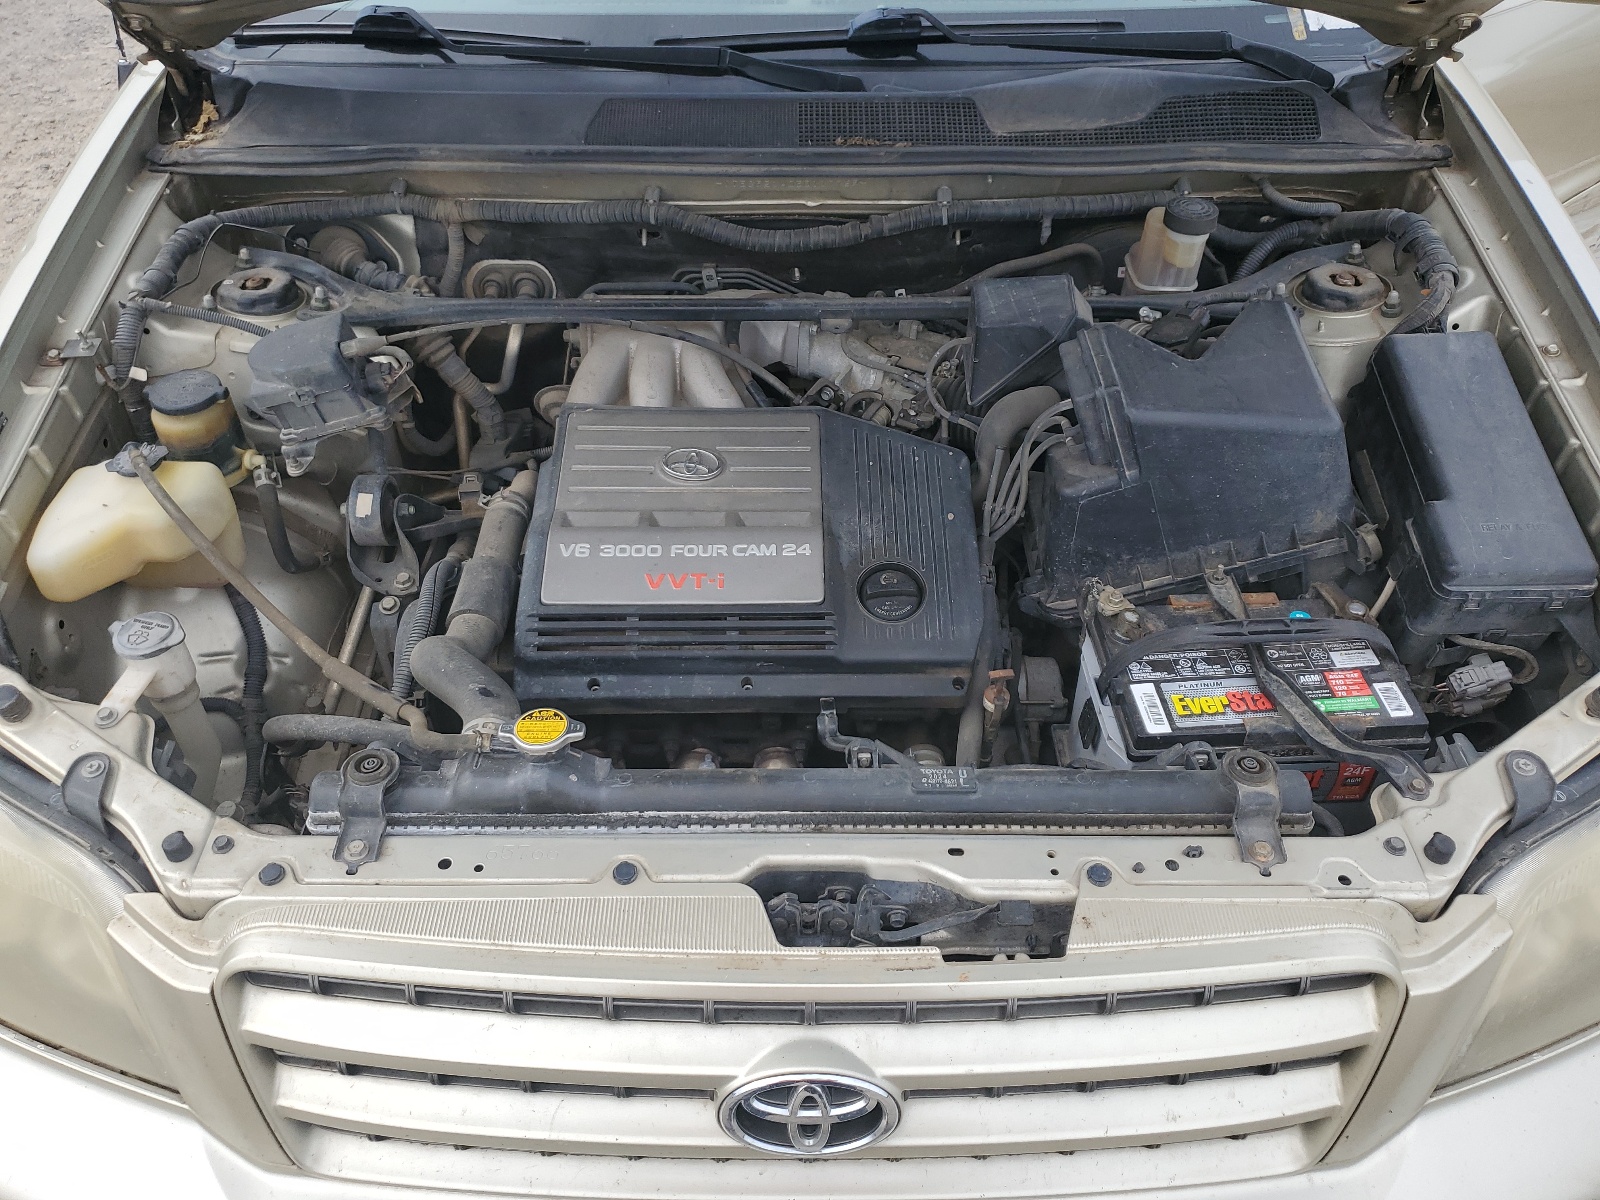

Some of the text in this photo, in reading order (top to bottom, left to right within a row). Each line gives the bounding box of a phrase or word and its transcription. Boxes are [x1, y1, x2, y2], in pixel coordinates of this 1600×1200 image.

[559, 543, 812, 557] V6 3000 FOUR CAM 24
[644, 573, 725, 590] VVT-i
[1178, 681, 1223, 689] PLATINUM
[1171, 691, 1274, 715] EverSta
[1344, 767, 1371, 775] 24F
